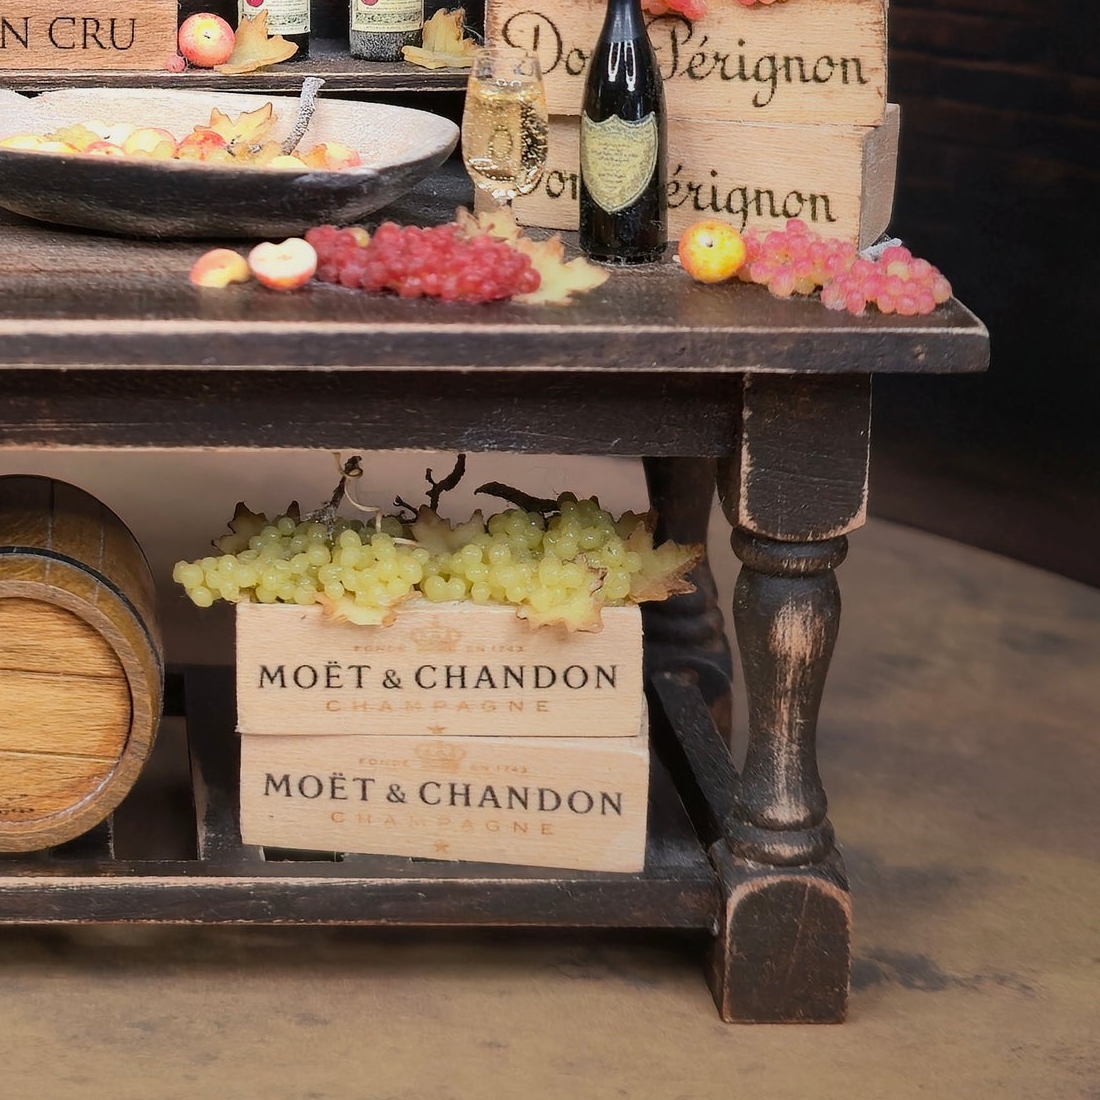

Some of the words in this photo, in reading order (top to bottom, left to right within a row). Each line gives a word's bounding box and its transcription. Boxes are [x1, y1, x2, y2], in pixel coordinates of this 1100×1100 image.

[49, 16, 136, 50] CRU
[502, 10, 591, 76] Do
[644, 13, 869, 109] Pérignon
[665, 164, 837, 235] érignon
[258, 661, 372, 690] MOËT
[382, 668, 402, 690] &
[414, 663, 619, 690] CHANDON
[325, 699, 552, 714] CHAMPAGNE
[264, 772, 376, 802] MOËT
[386, 783, 407, 804] &
[418, 780, 623, 817] CHANDON
